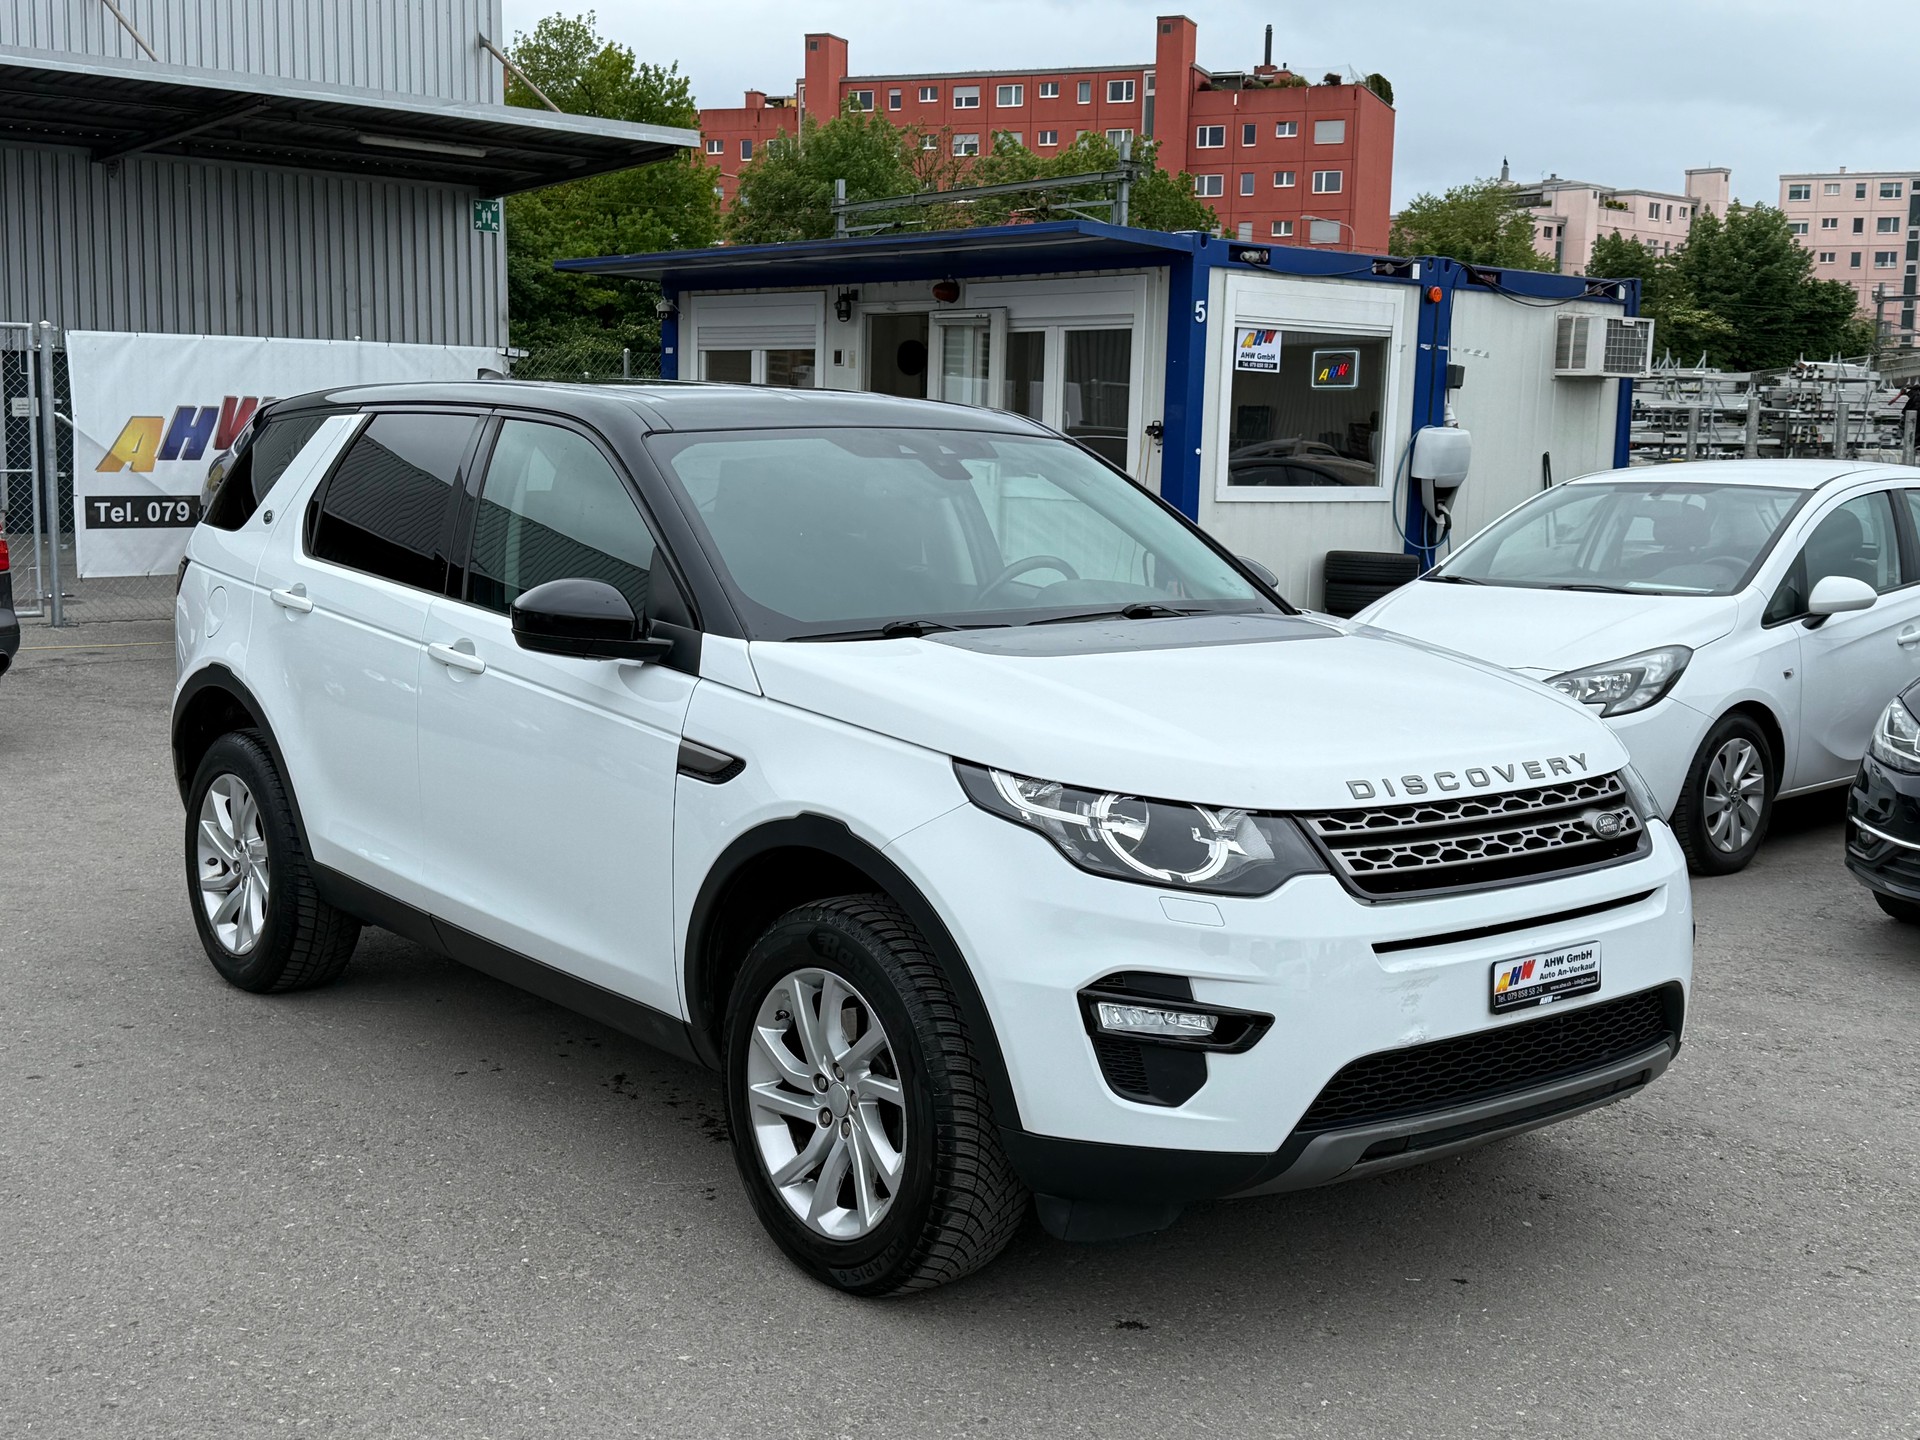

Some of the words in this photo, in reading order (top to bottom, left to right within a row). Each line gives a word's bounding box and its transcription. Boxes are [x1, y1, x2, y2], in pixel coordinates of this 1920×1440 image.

[1194, 300, 1206, 323] 5
[1240, 329, 1277, 348] AHW
[1240, 351, 1256, 360] AHW
[1256, 352, 1276, 361] GmbH
[1318, 362, 1350, 381] AHW
[94, 502, 139, 523] Tel.
[146, 502, 190, 522] 079
[1346, 752, 1588, 800] DISCOVERY
[1543, 955, 1564, 969] AHW
[1566, 949, 1593, 963] GmbH
[1495, 959, 1537, 993] AHW
[1539, 971, 1556, 981] Auto
[1557, 960, 1596, 977] An-Verkauf
[1507, 990, 1518, 1001] 079
[1536, 985, 1543, 994] 24
[851, 1232, 905, 1281] POLARIS
[838, 1270, 848, 1282] 6
